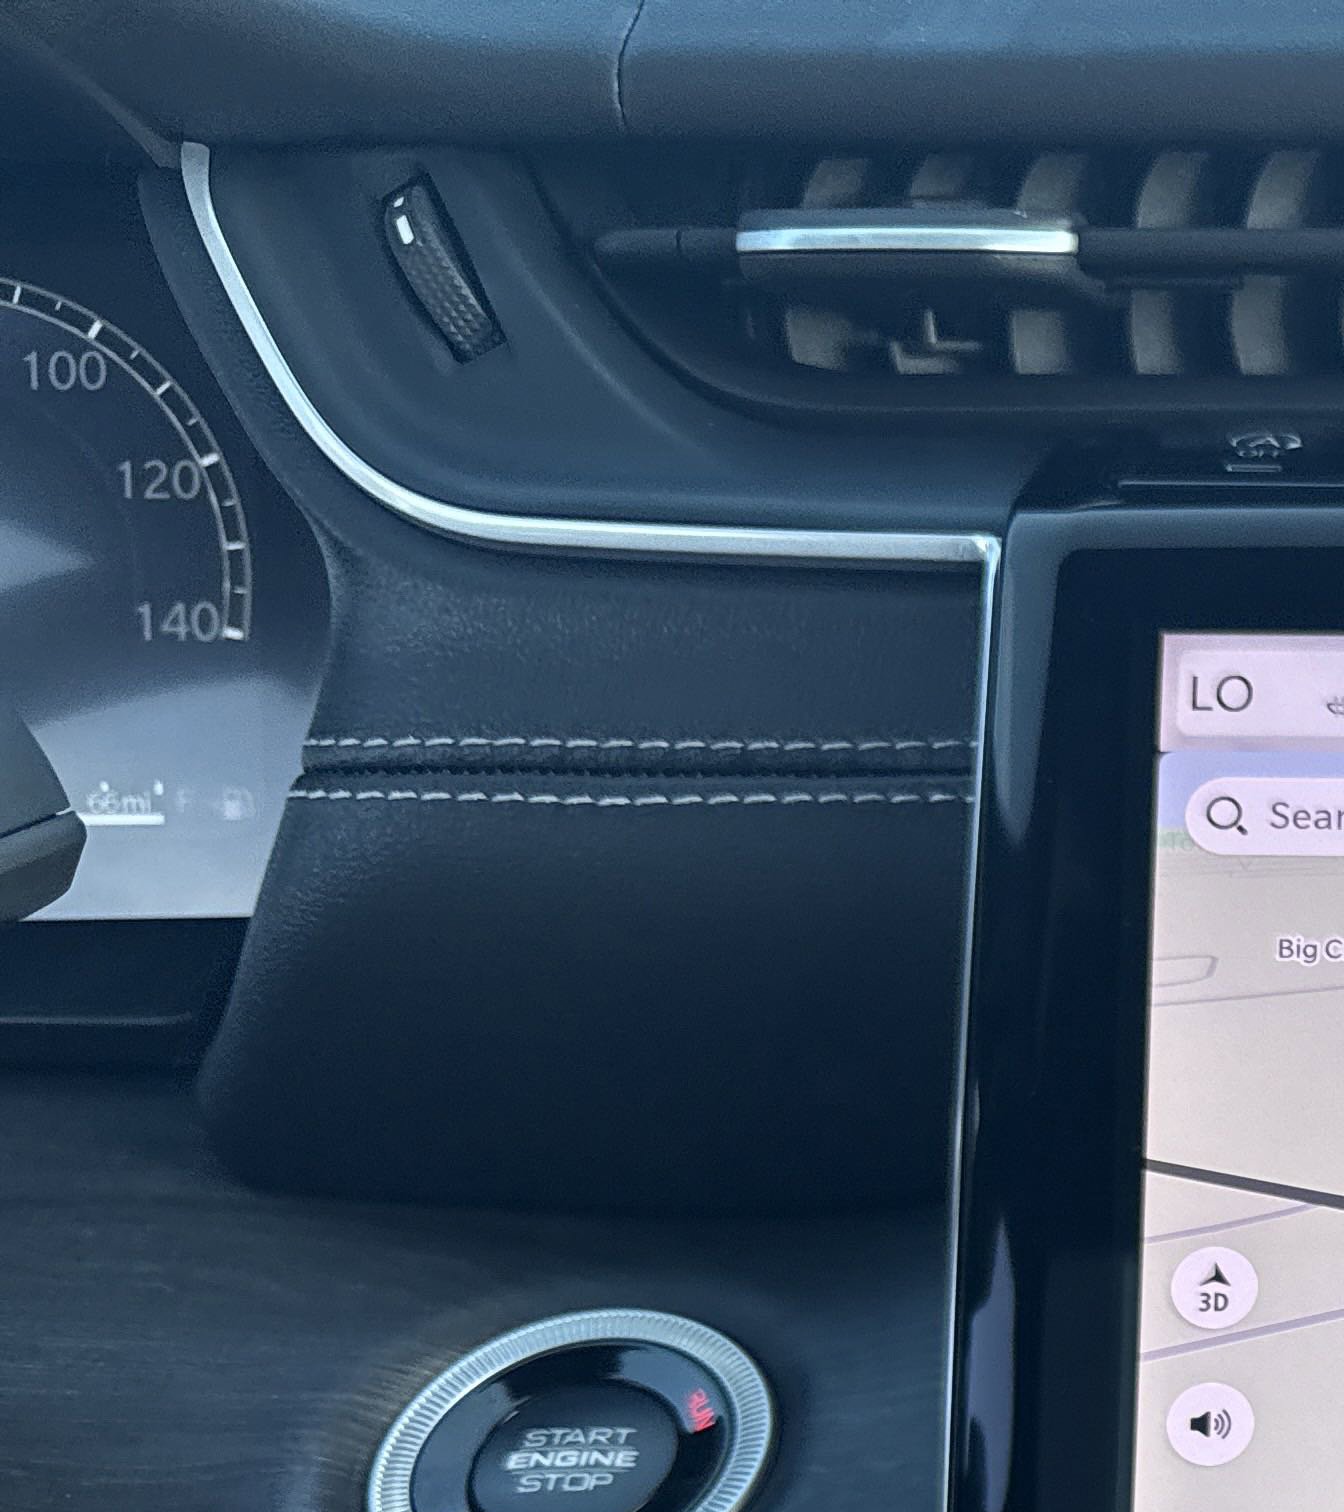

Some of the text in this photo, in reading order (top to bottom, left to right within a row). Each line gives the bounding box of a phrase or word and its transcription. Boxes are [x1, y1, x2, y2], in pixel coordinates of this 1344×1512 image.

[23, 350, 107, 391] 100
[117, 459, 199, 500] 120
[136, 600, 222, 643] 140
[1190, 674, 1253, 713] LO
[1278, 938, 1318, 964] Big
[1197, 1292, 1229, 1313] 3D
[525, 1427, 636, 1447] START
[506, 1450, 639, 1469] ENGINE
[516, 1472, 613, 1493] STOP
